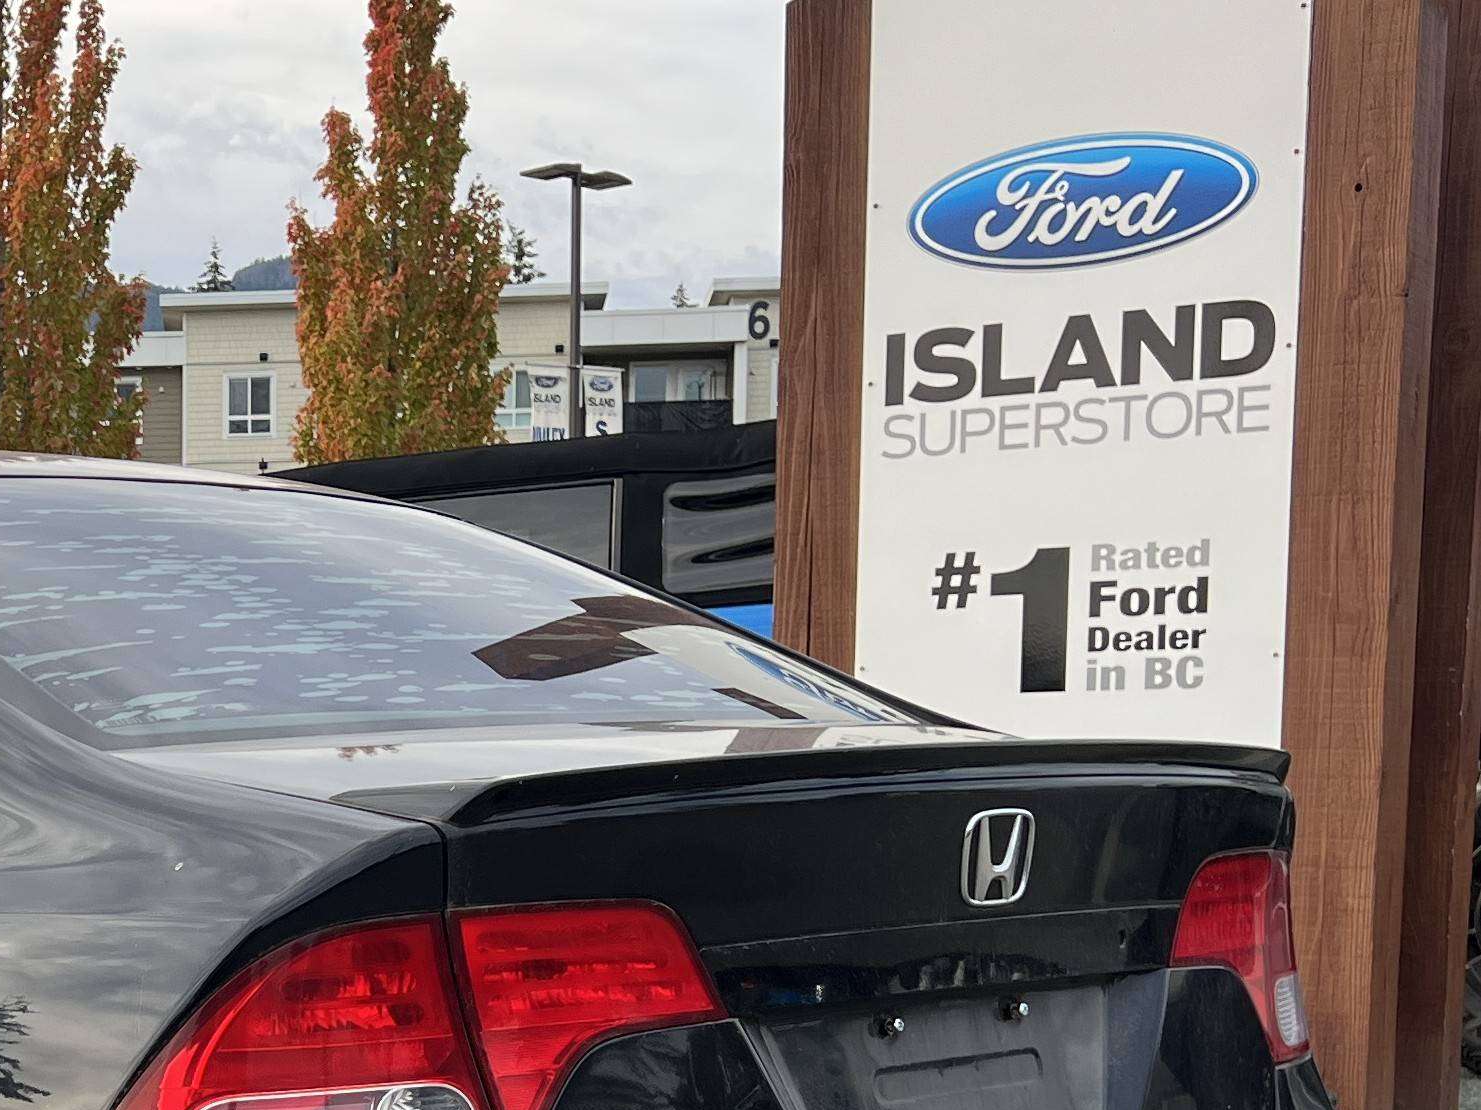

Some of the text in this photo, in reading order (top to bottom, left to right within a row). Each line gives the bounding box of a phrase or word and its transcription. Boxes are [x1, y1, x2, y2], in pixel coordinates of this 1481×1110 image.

[974, 155, 1185, 252] Ford
[883, 299, 1277, 407] ISLAND
[881, 384, 1272, 460] SUPERSTORE
[1090, 538, 1211, 572] Rated
[1088, 576, 1209, 619] Ford
[1087, 624, 1207, 653] Dealer
[1086, 656, 1204, 691] in BC
